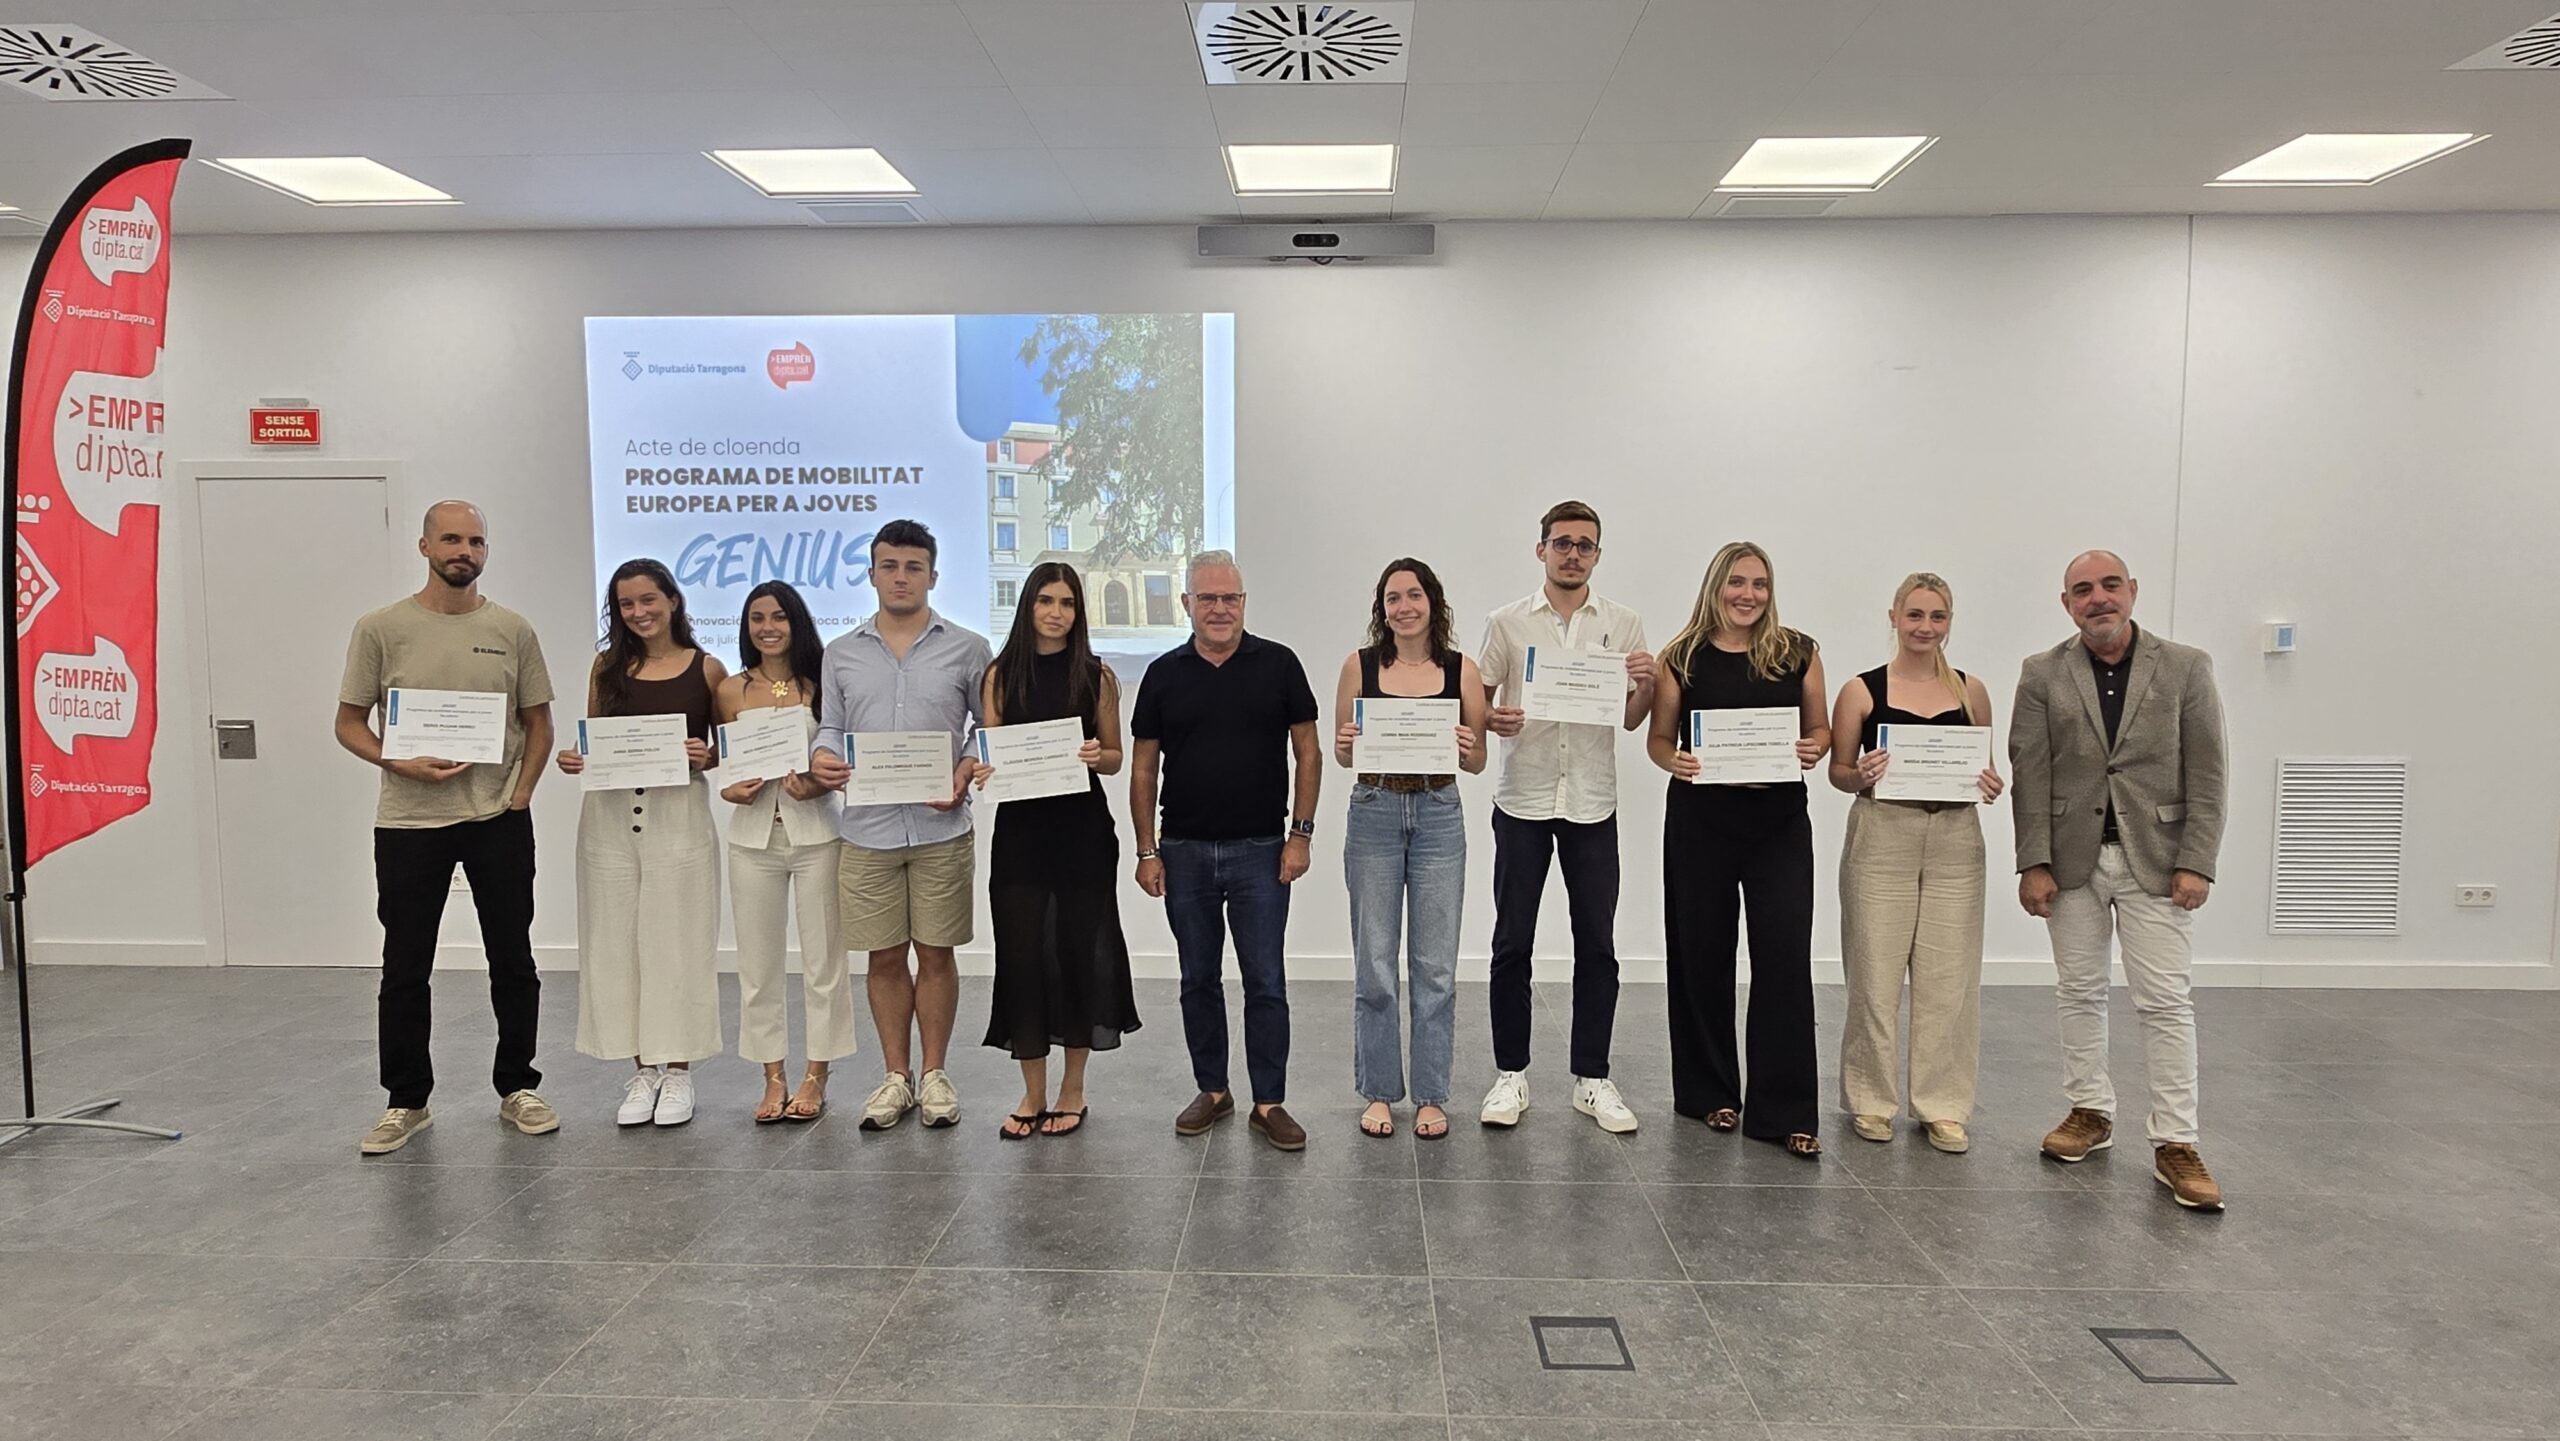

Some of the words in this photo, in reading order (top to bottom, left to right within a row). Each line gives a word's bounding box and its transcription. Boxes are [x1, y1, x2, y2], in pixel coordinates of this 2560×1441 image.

[648, 363, 695, 376] Diputació
[697, 364, 747, 376] Tarragona
[264, 415, 305, 426] SENSE
[259, 428, 312, 438] SORTIDA
[625, 439, 673, 456] Acte
[679, 438, 707, 456] de
[713, 437, 801, 456] cloenda
[625, 468, 761, 486] PROGRAMA
[765, 468, 794, 485] DE
[799, 466, 924, 485] MOBILITAT
[626, 494, 734, 513] EUROPEA
[737, 494, 777, 512] PER
[782, 494, 799, 512] A
[803, 494, 878, 512] JOVES
[674, 529, 875, 590] GENIUS
[842, 616, 857, 626] de
[699, 634, 715, 645] de
[48, 691, 122, 722] dipta.cat
